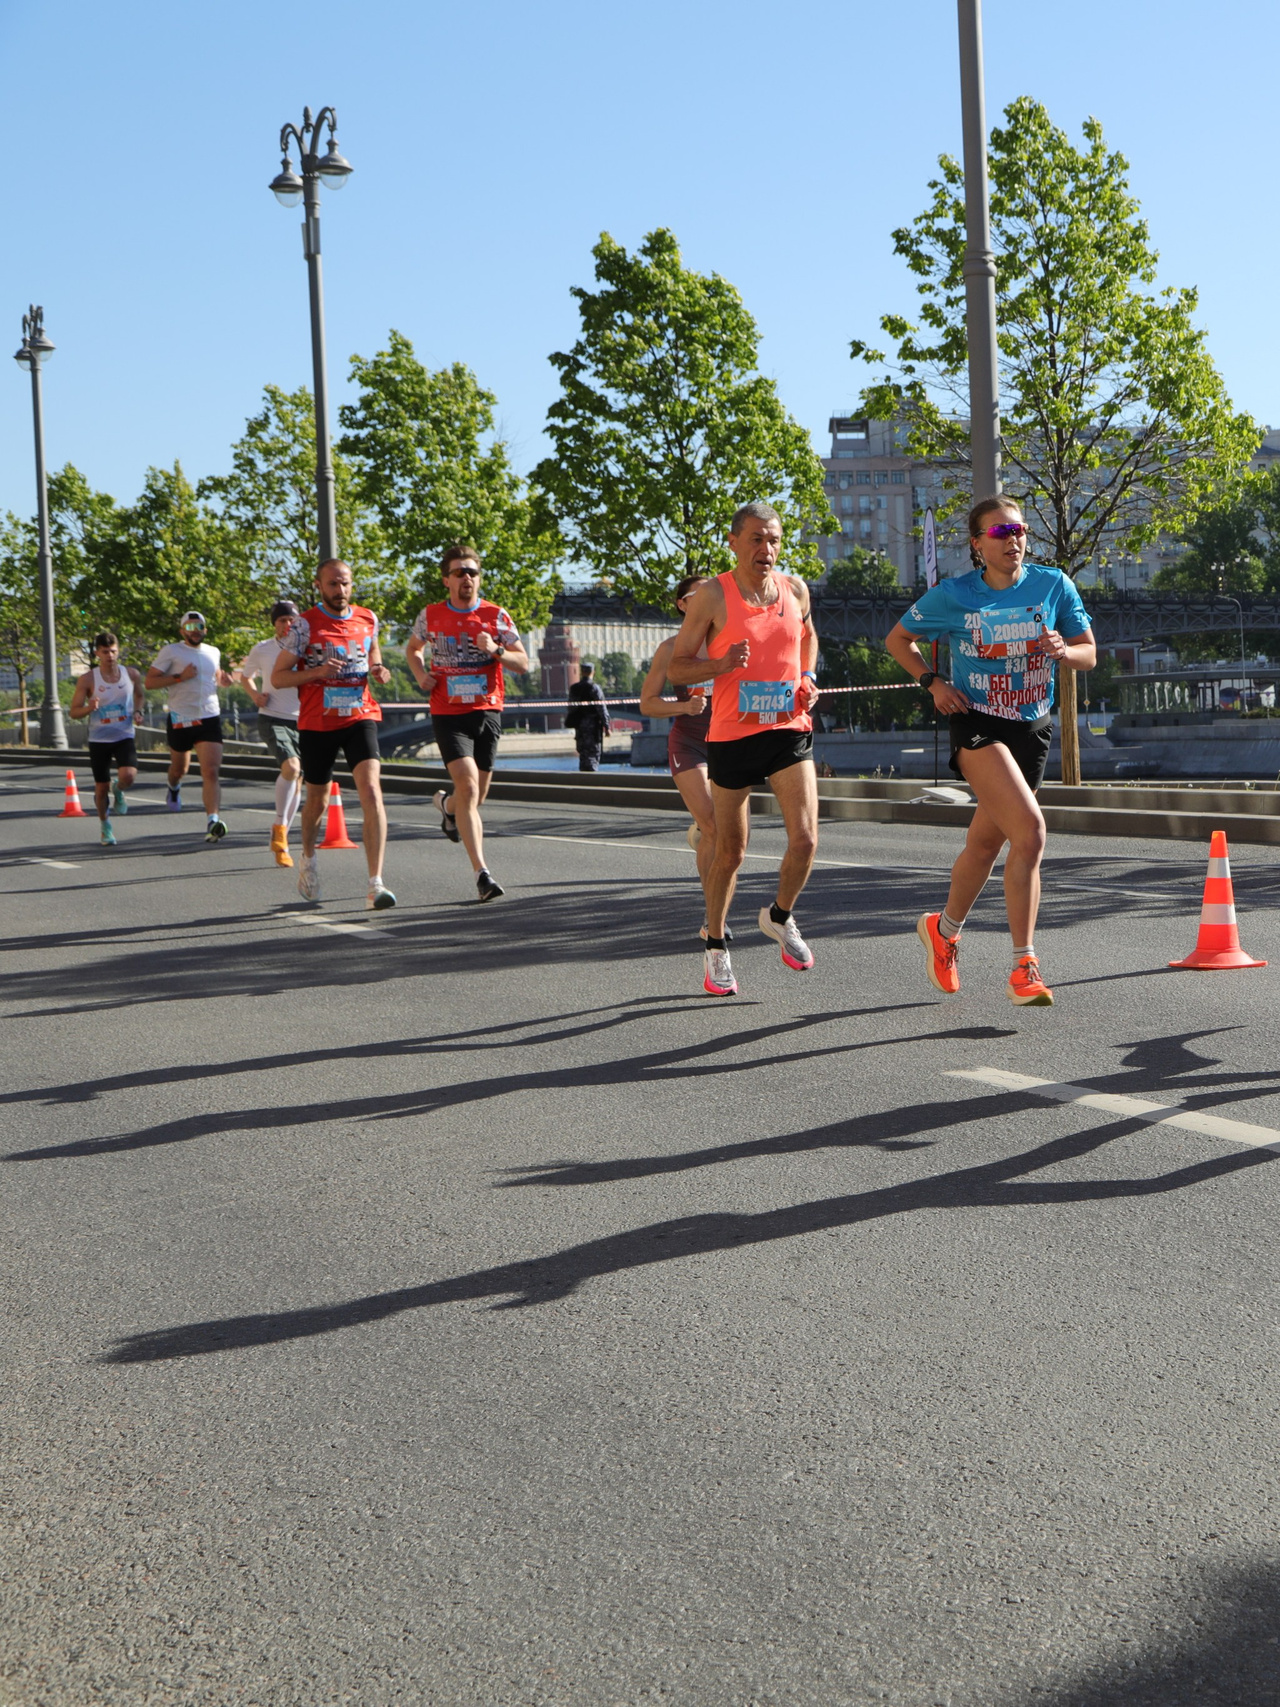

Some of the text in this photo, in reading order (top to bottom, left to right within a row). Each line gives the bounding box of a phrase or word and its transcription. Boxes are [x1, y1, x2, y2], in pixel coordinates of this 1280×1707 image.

[993, 621, 1036, 642] 20809
[968, 672, 1012, 691] #ЗАБЕГ
[751, 694, 785, 710] 21743
[987, 685, 1046, 707] #ГОРДОСТЬ
